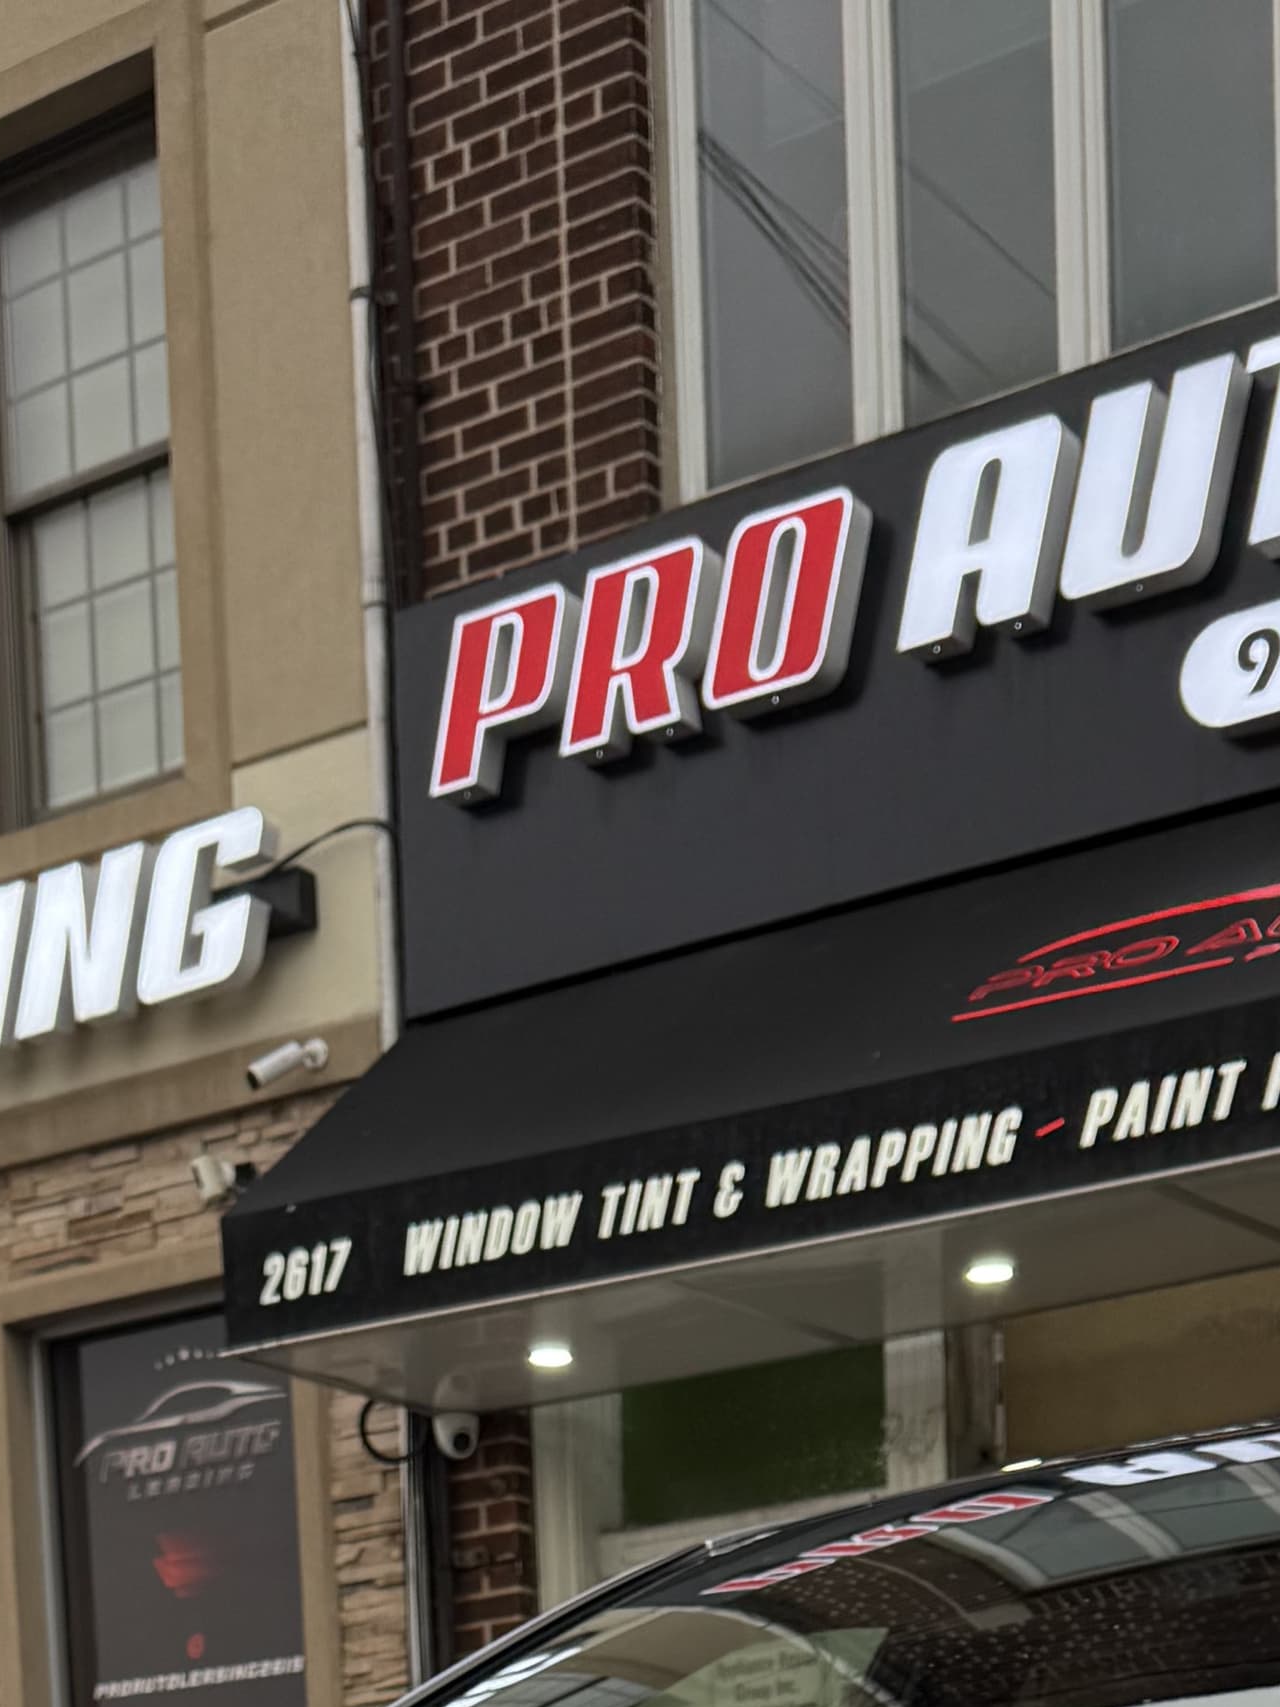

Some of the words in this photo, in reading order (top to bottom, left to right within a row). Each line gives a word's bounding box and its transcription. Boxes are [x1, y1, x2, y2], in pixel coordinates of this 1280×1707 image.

[428, 485, 870, 803] PRO
[968, 936, 1181, 1001] PRO
[259, 1237, 352, 1306] 2617
[403, 1193, 584, 1277] WINDOW
[598, 1170, 701, 1240] TINT
[713, 1161, 746, 1218] &
[766, 1106, 1024, 1207] WRAPPING
[1078, 1059, 1247, 1149] PAINT
[99, 1439, 178, 1485] PRO
[181, 1419, 282, 1469] AUTO
